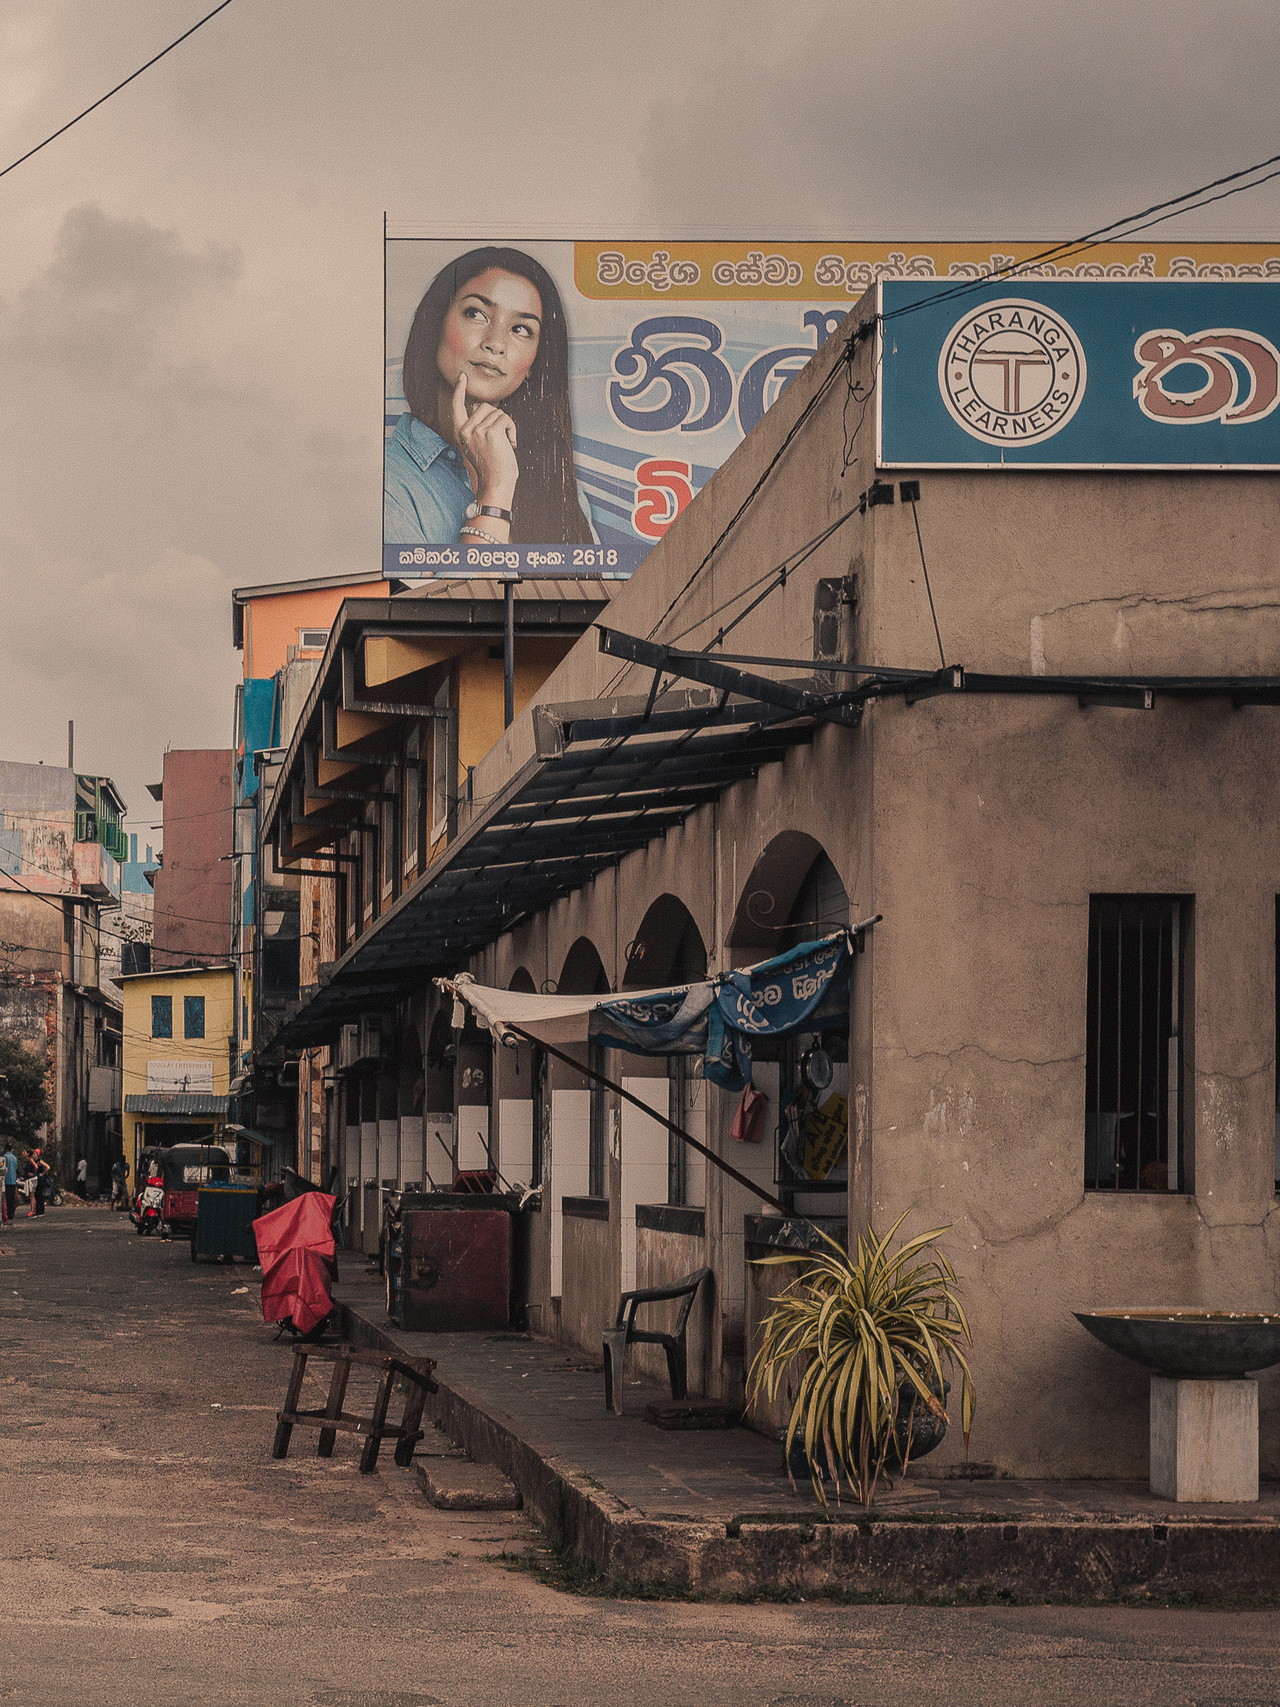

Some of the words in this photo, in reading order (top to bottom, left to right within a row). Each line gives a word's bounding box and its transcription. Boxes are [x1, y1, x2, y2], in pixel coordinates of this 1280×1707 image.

[598, 252, 700, 290] විදේශ
[713, 252, 803, 286] සේවා
[951, 311, 1070, 366] THARANGA
[953, 387, 1070, 436] LEARNERS
[398, 549, 460, 566] කම්කරු
[526, 549, 566, 566] අංක:
[573, 549, 618, 566] 2618
